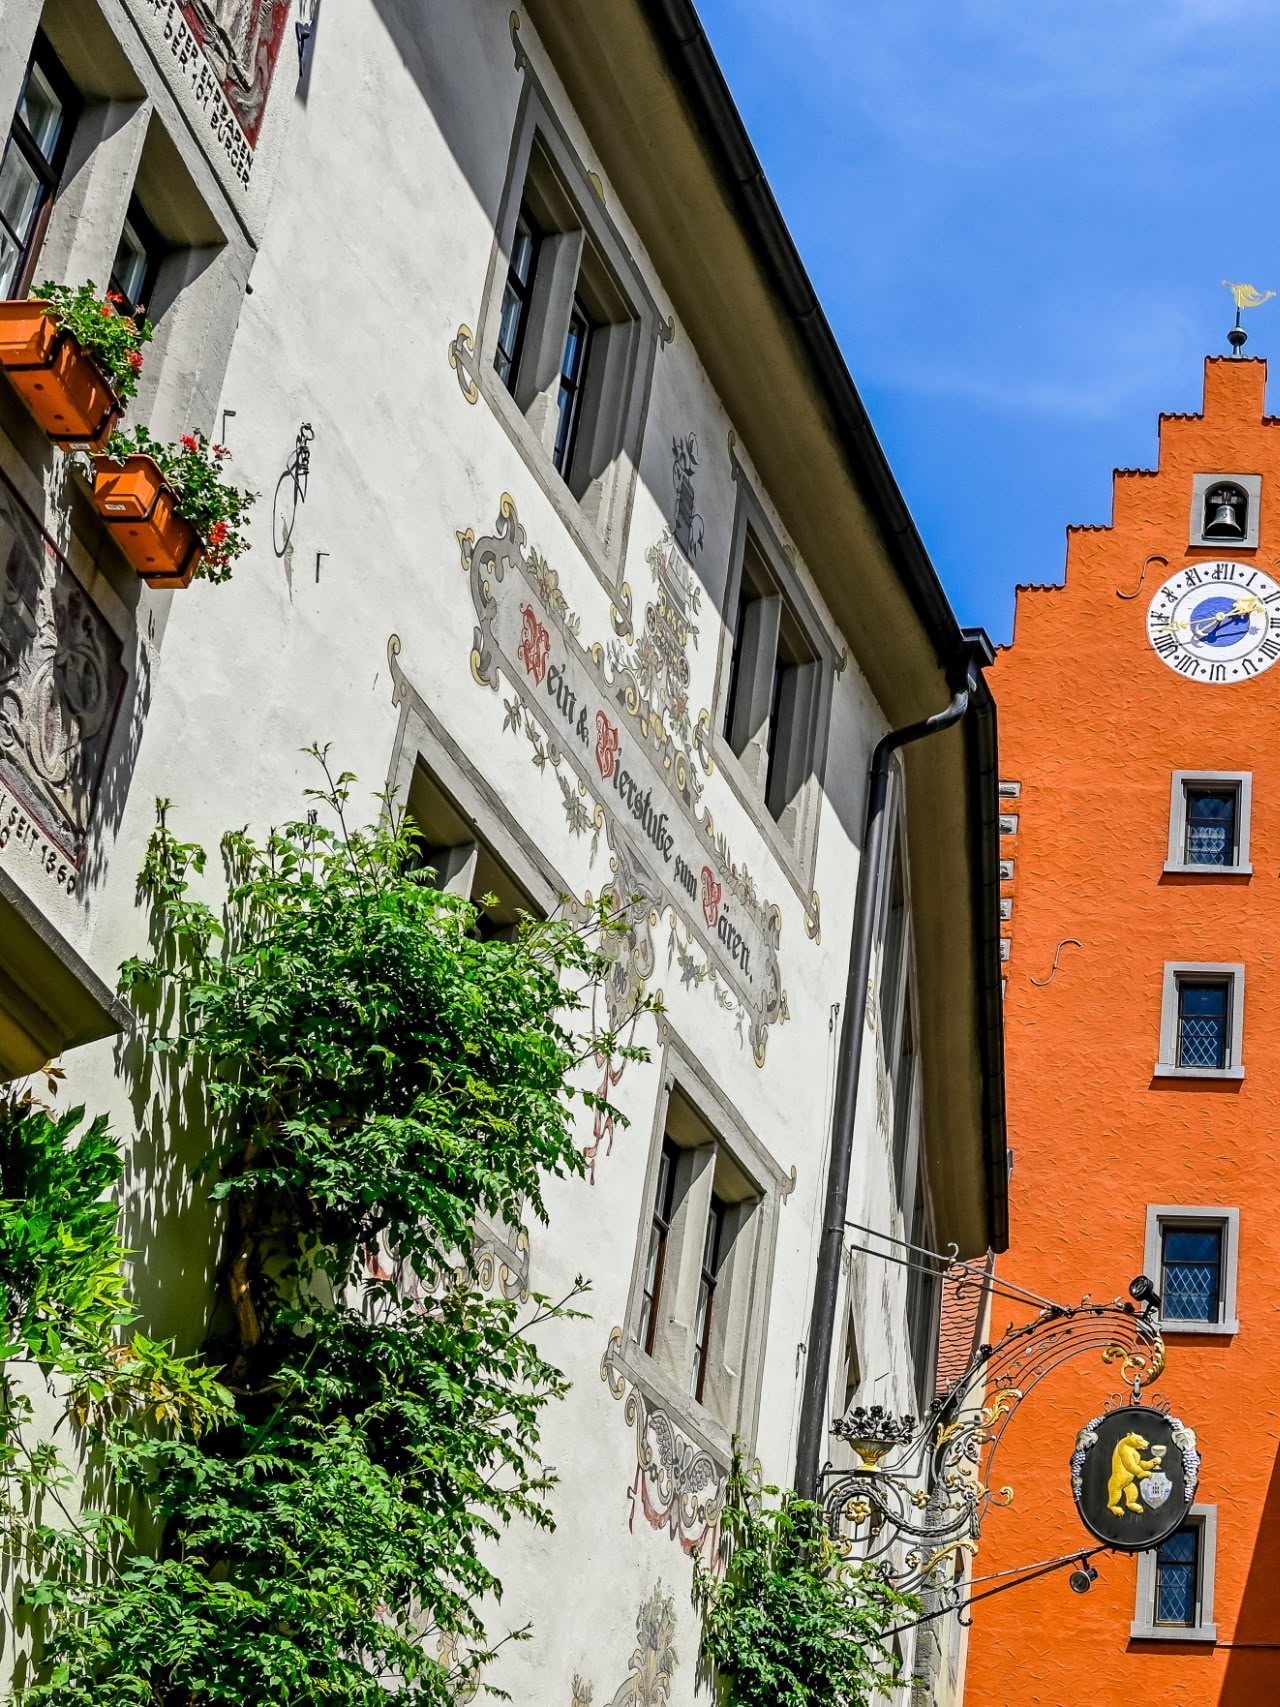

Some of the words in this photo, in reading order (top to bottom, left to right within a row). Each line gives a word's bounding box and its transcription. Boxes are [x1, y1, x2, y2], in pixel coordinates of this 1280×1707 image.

[164, 21, 188, 73] DER
[178, 21, 198, 67] DER
[200, 64, 254, 172] EHRBAREN
[517, 602, 577, 725] Wein
[576, 704, 590, 749] &
[595, 709, 676, 864] Bierstube
[8, 805, 40, 853] SEIT
